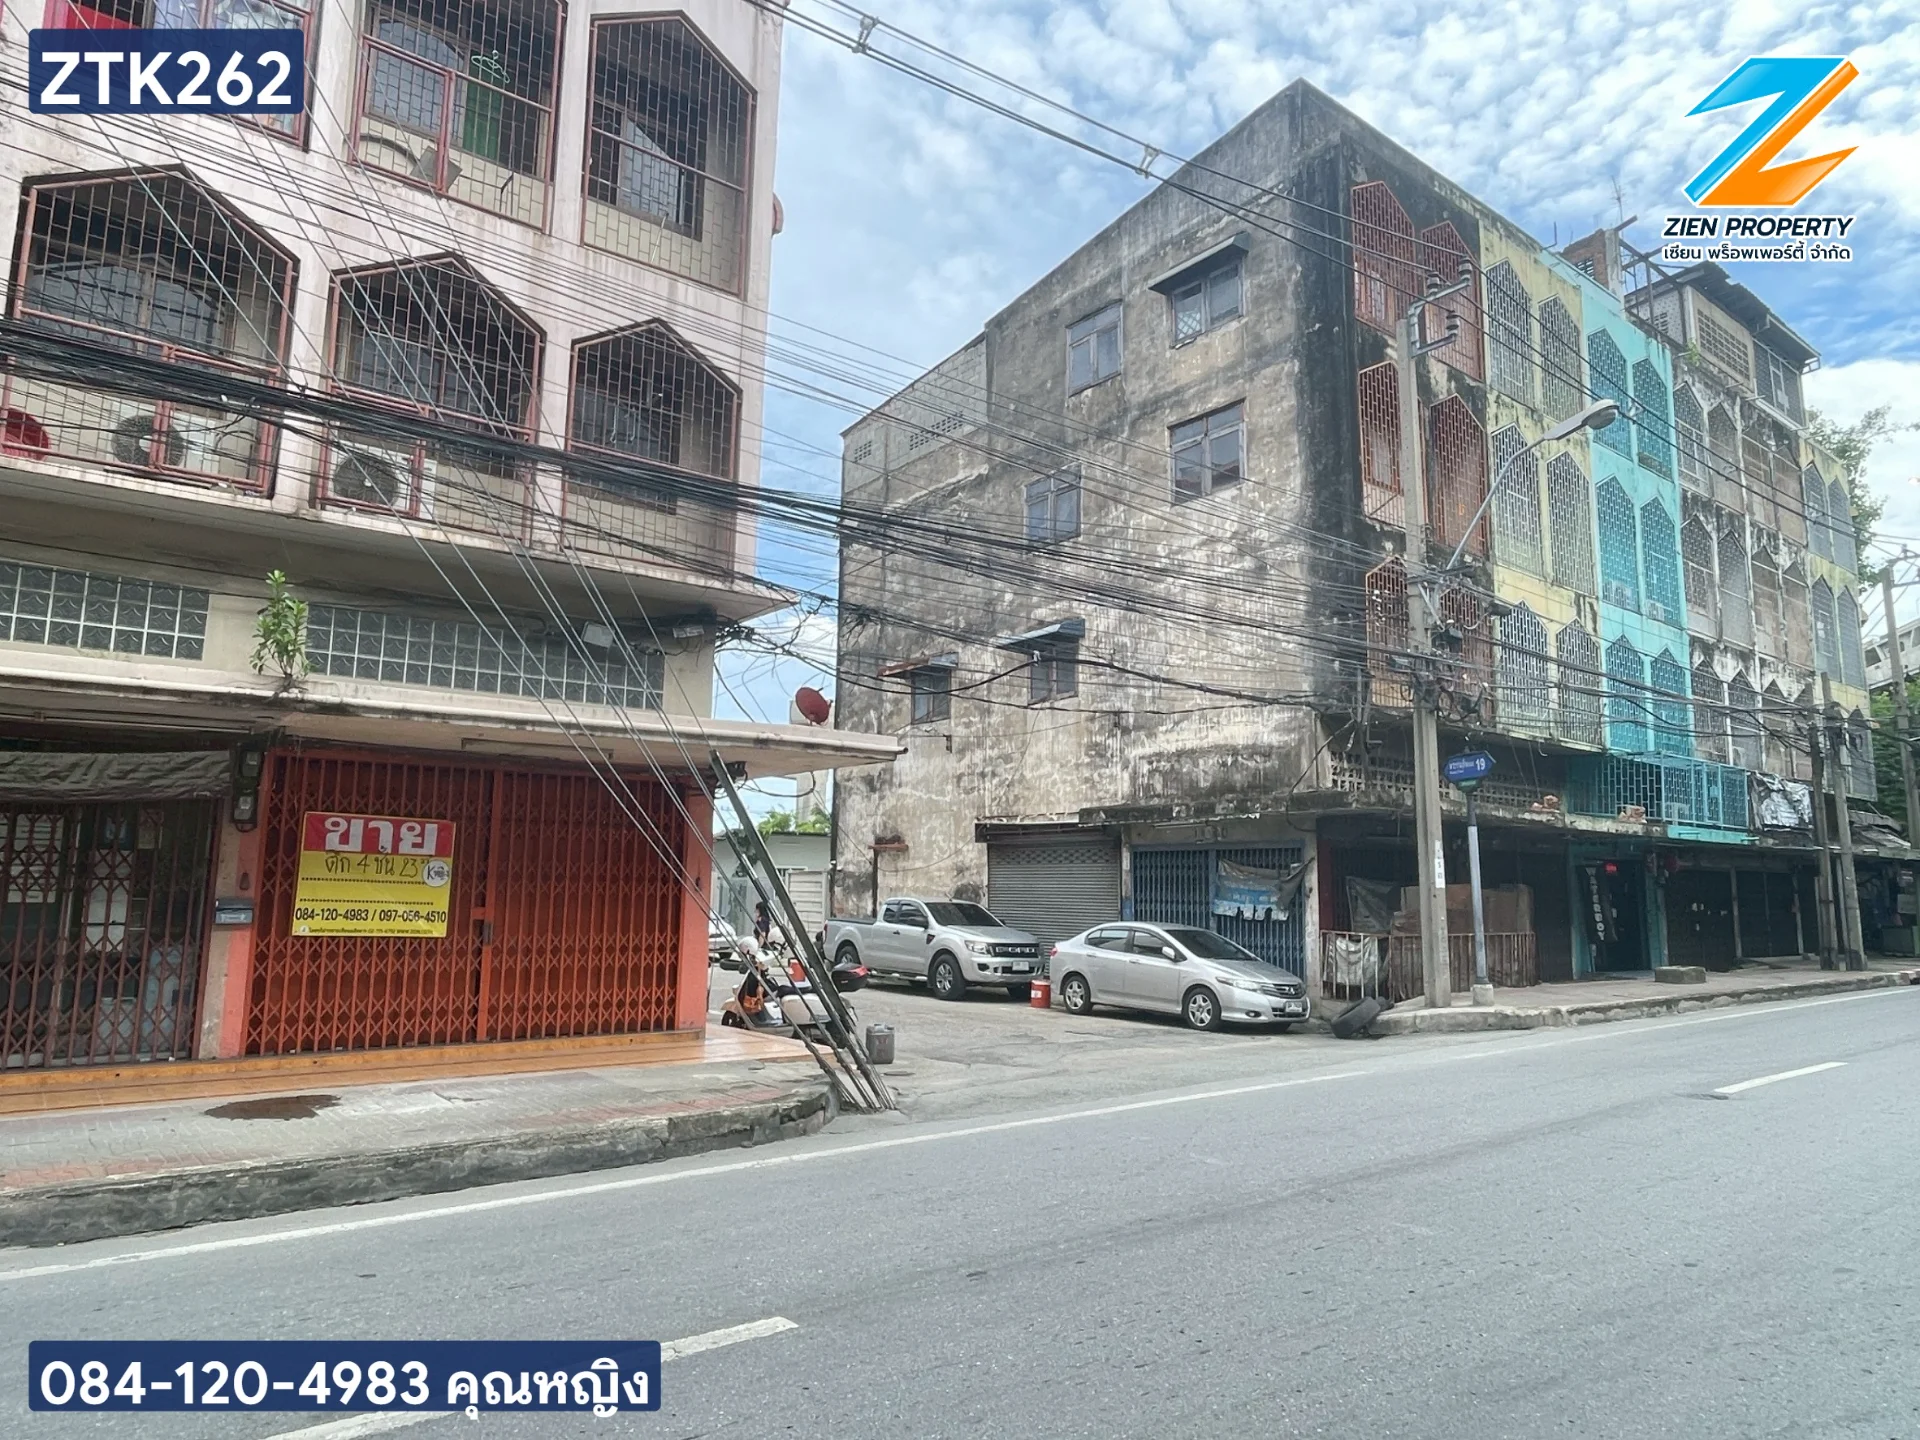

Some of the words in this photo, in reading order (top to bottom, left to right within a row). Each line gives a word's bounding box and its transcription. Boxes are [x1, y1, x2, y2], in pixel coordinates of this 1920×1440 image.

[1475, 758, 1486, 771] 19
[324, 817, 438, 856] ขาย
[357, 854, 371, 874] 4
[399, 857, 418, 878] 23
[295, 907, 369, 922] 084-120-4983
[379, 909, 447, 923] 097-056-4510
